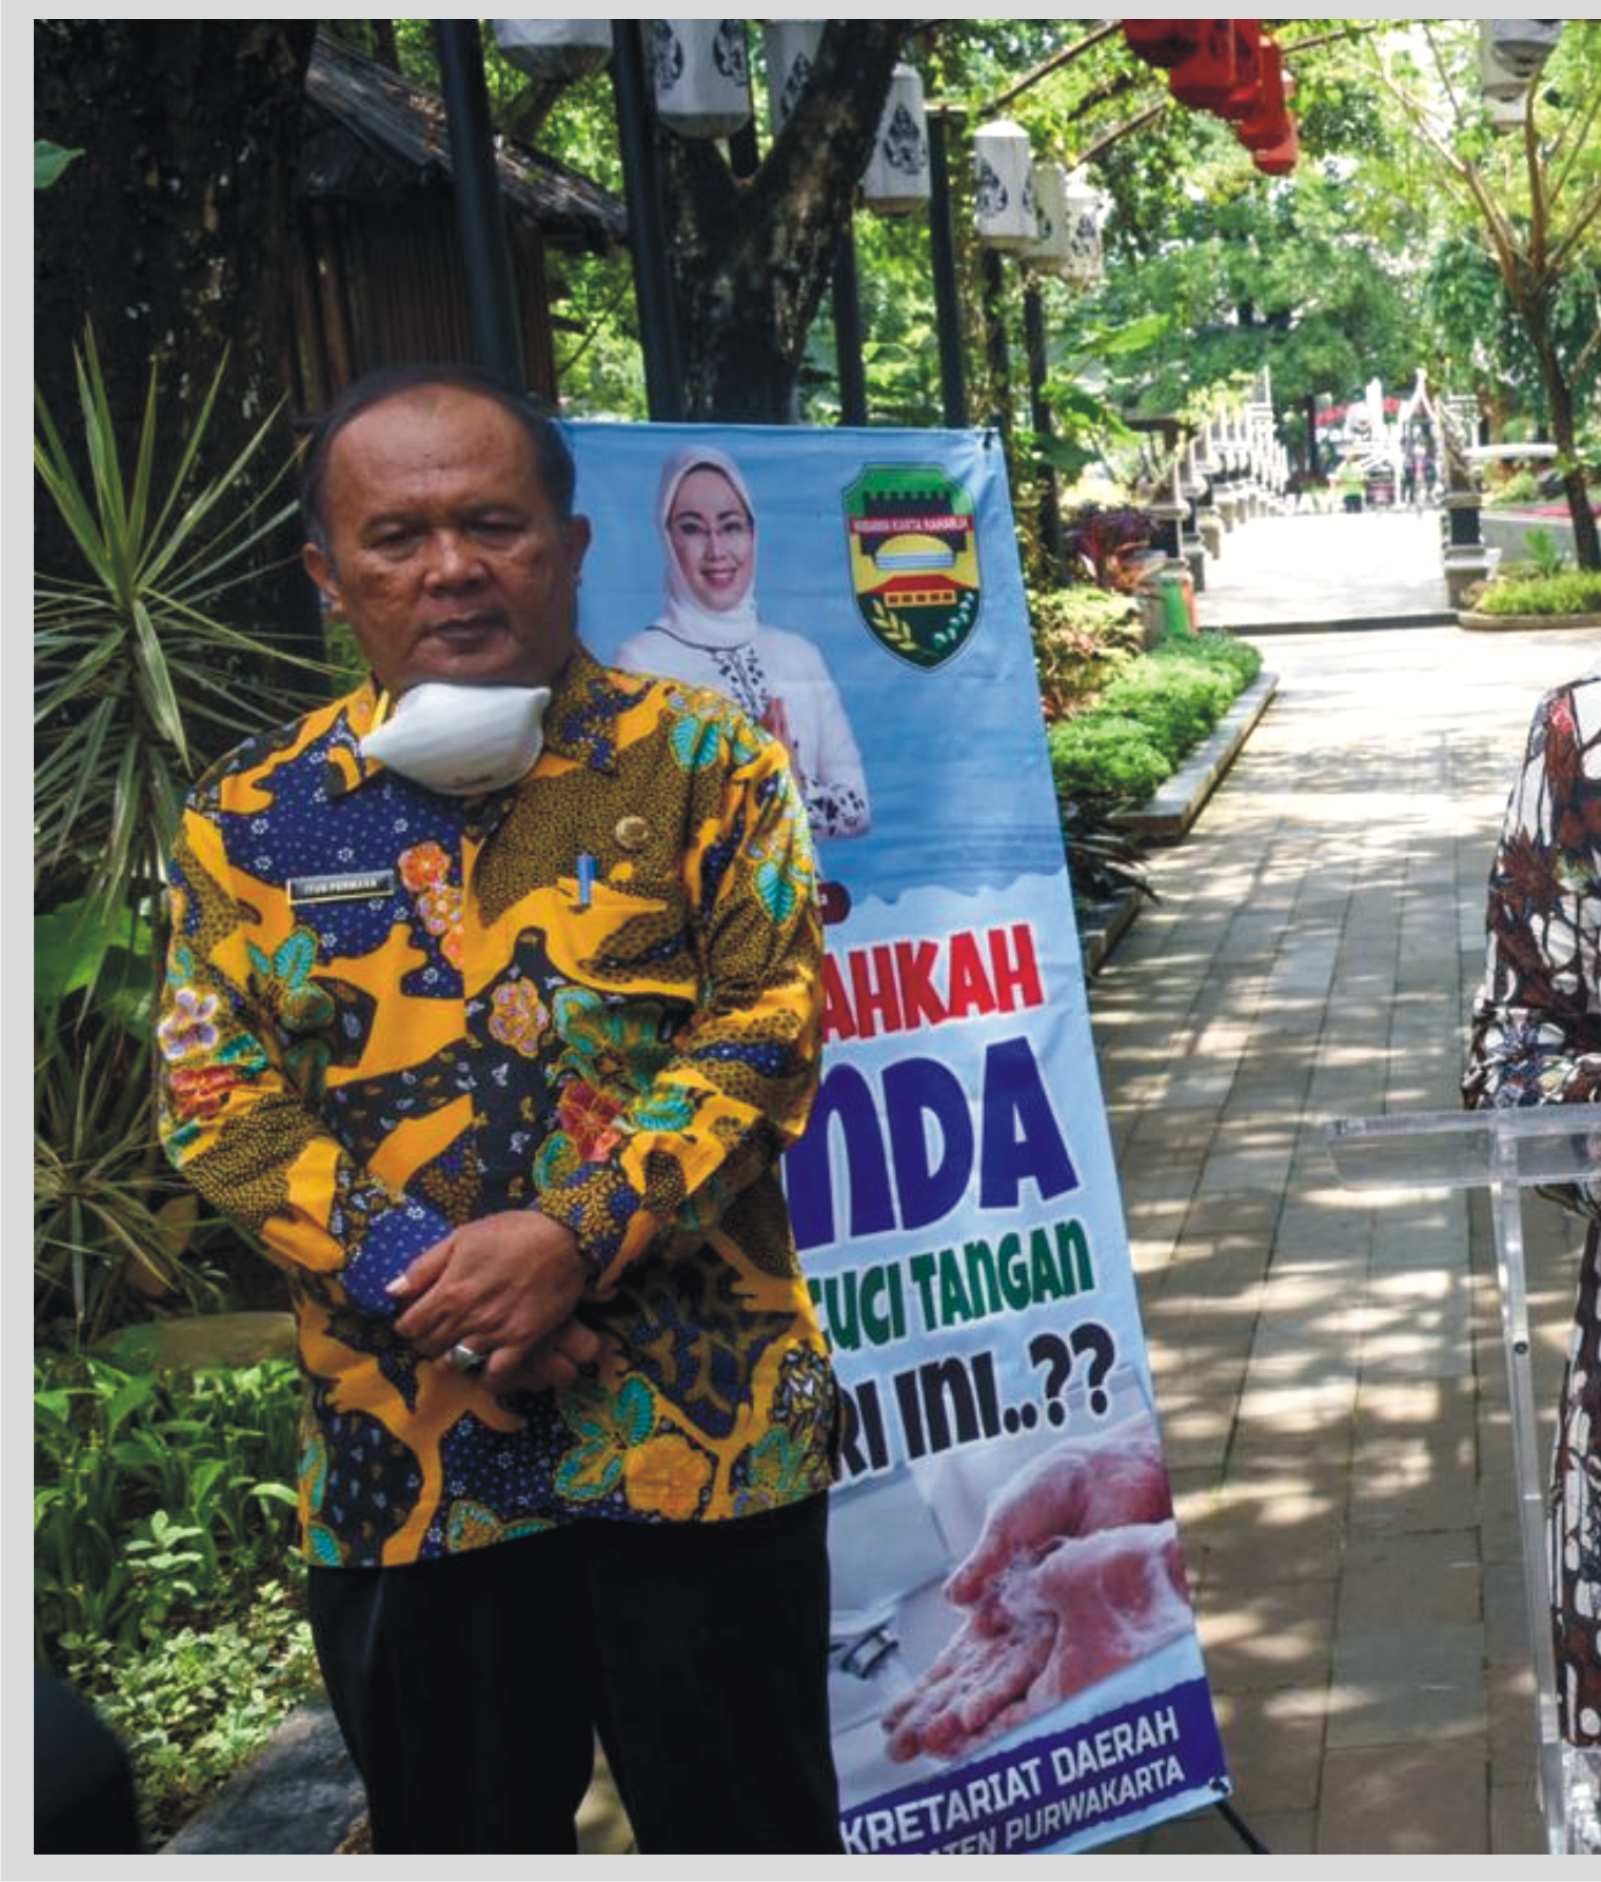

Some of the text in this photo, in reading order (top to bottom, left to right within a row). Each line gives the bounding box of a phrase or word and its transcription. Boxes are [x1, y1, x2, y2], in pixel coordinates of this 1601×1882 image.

[910, 1217, 1095, 1333] TANGAN
[1050, 1705, 1180, 1787] DAERAH
[1004, 1754, 1186, 1850] PURWAKARTA
